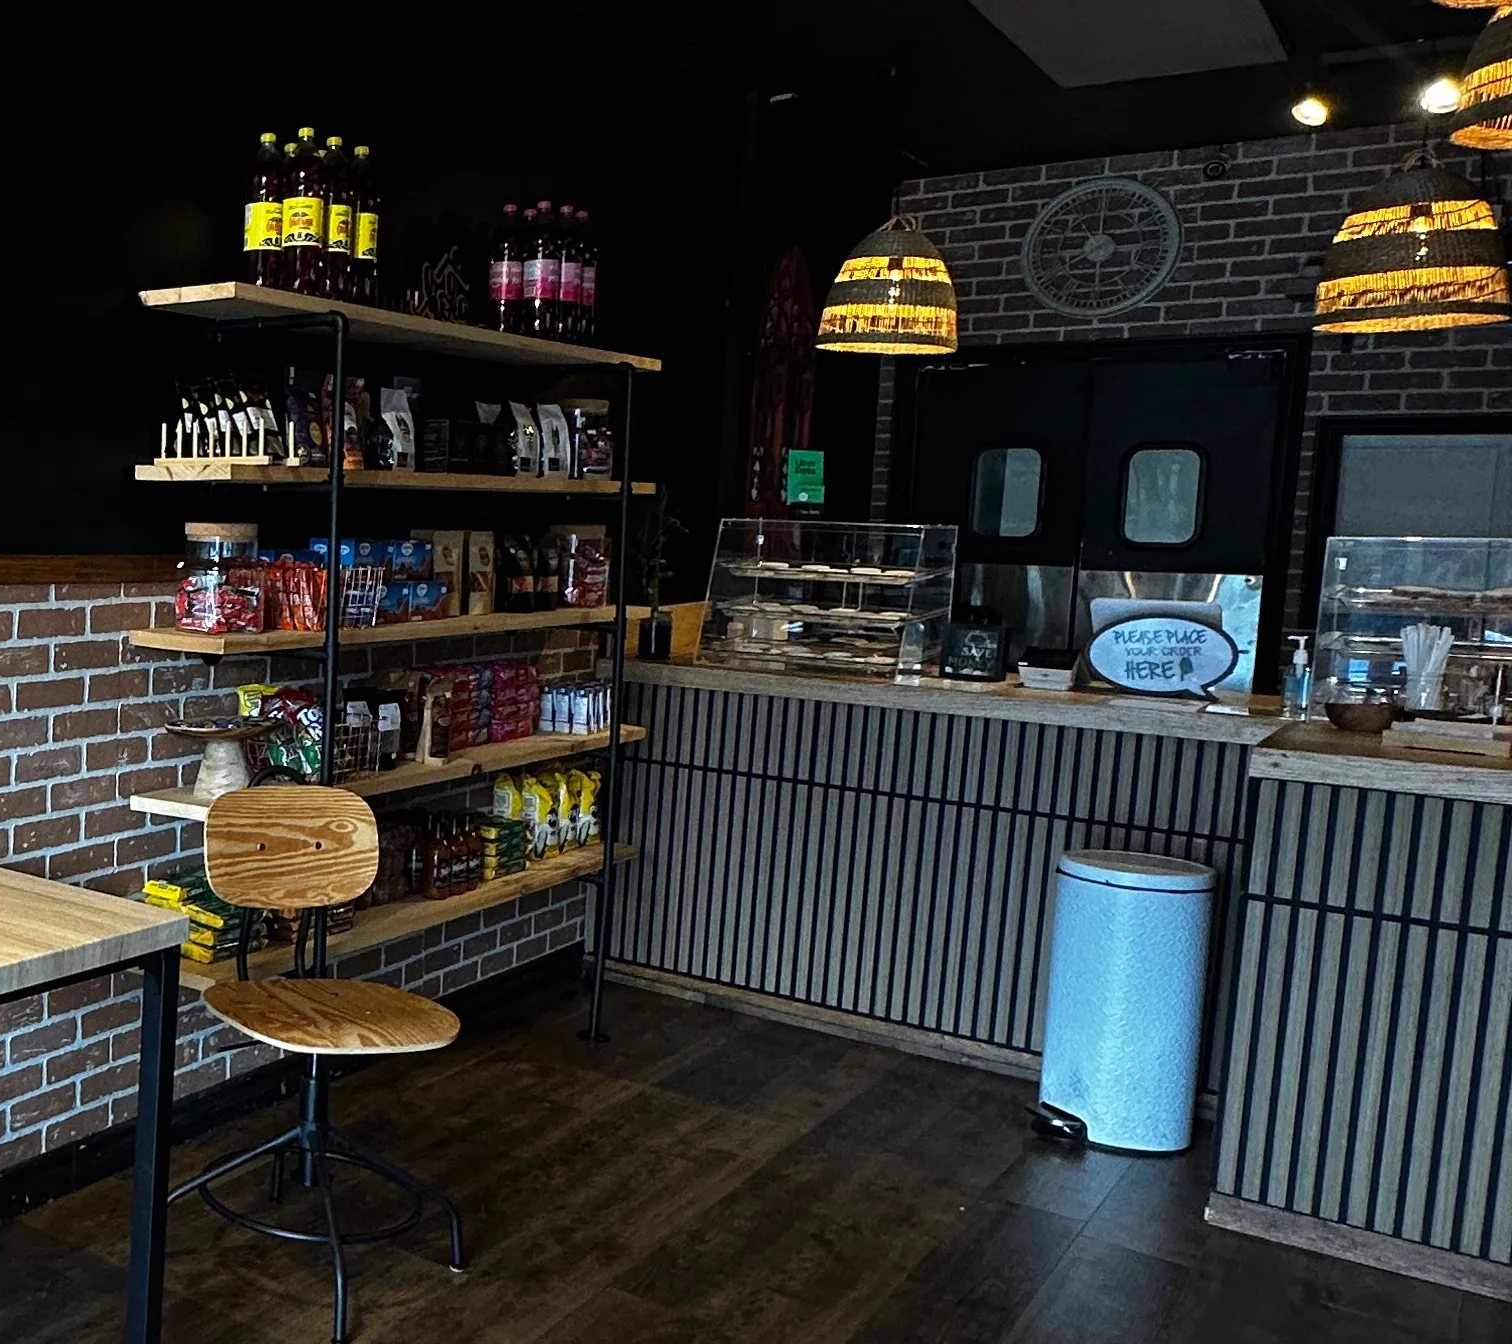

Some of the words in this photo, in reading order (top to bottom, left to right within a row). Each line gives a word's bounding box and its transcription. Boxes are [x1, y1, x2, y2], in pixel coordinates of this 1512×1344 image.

[1112, 629, 1164, 645] PLEASE
[1165, 629, 1207, 644] PLACE
[961, 647, 993, 659] SAVE
[1125, 646, 1155, 657] YOUR
[1161, 646, 1202, 656] ORDER
[1123, 657, 1176, 681] HERE
